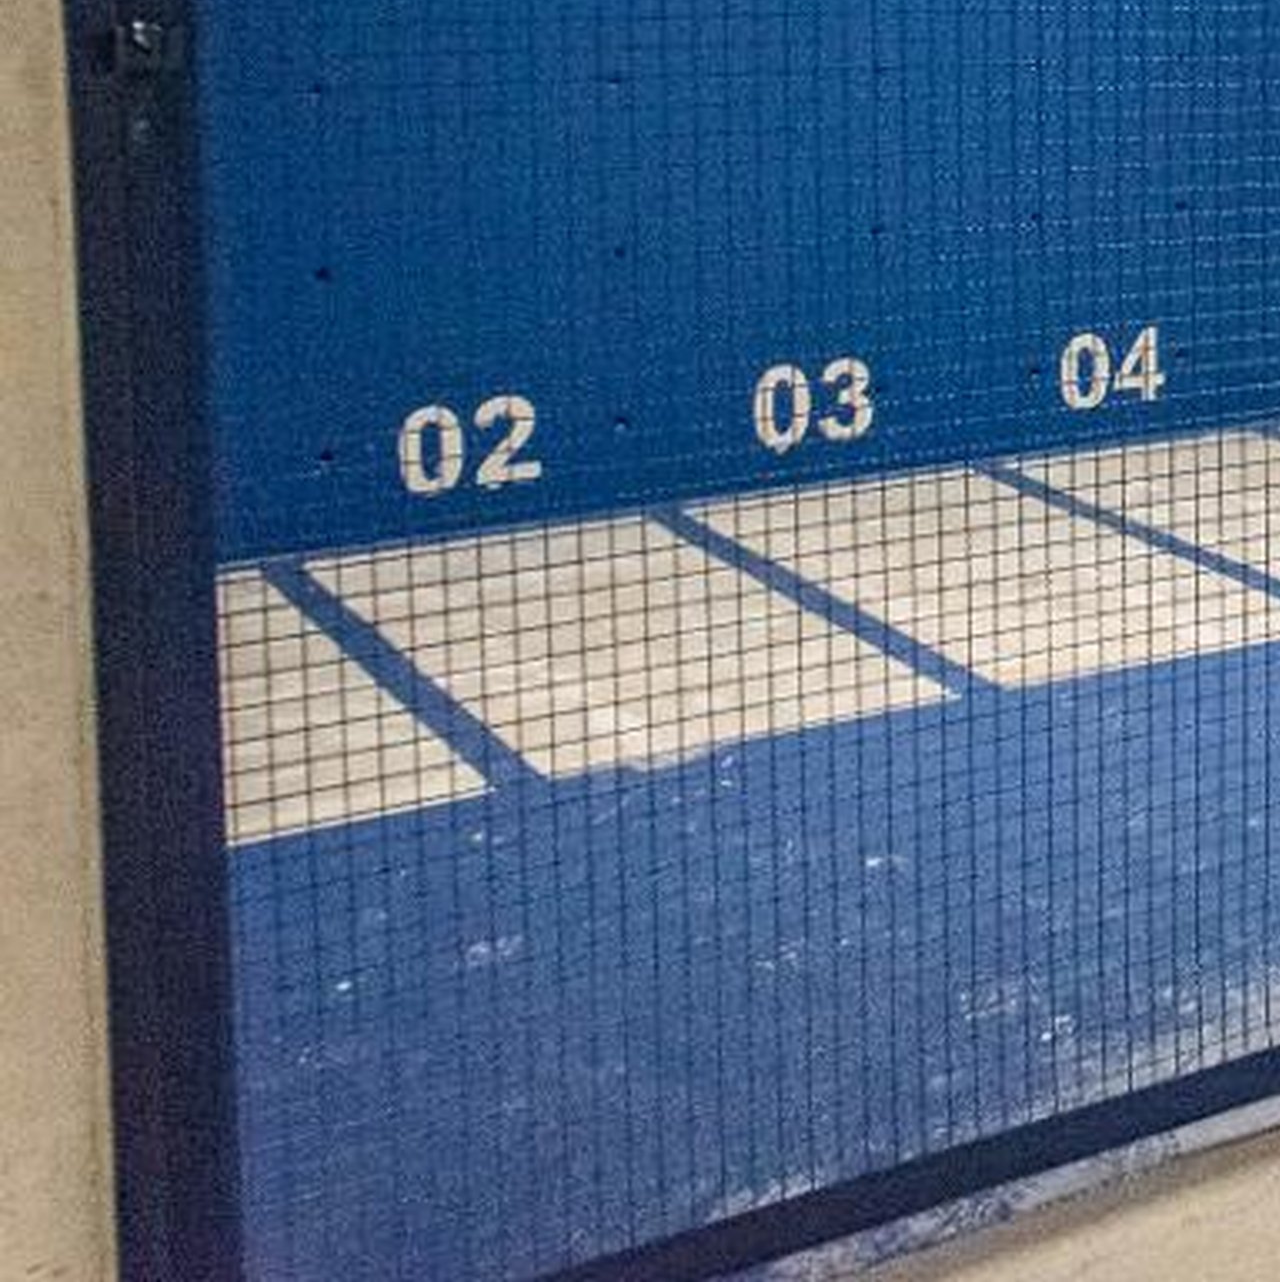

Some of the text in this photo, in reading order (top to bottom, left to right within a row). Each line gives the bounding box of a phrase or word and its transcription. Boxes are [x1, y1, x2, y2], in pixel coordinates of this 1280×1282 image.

[753, 359, 873, 453] 03
[1060, 326, 1164, 409] 04
[400, 396, 542, 494] 02
